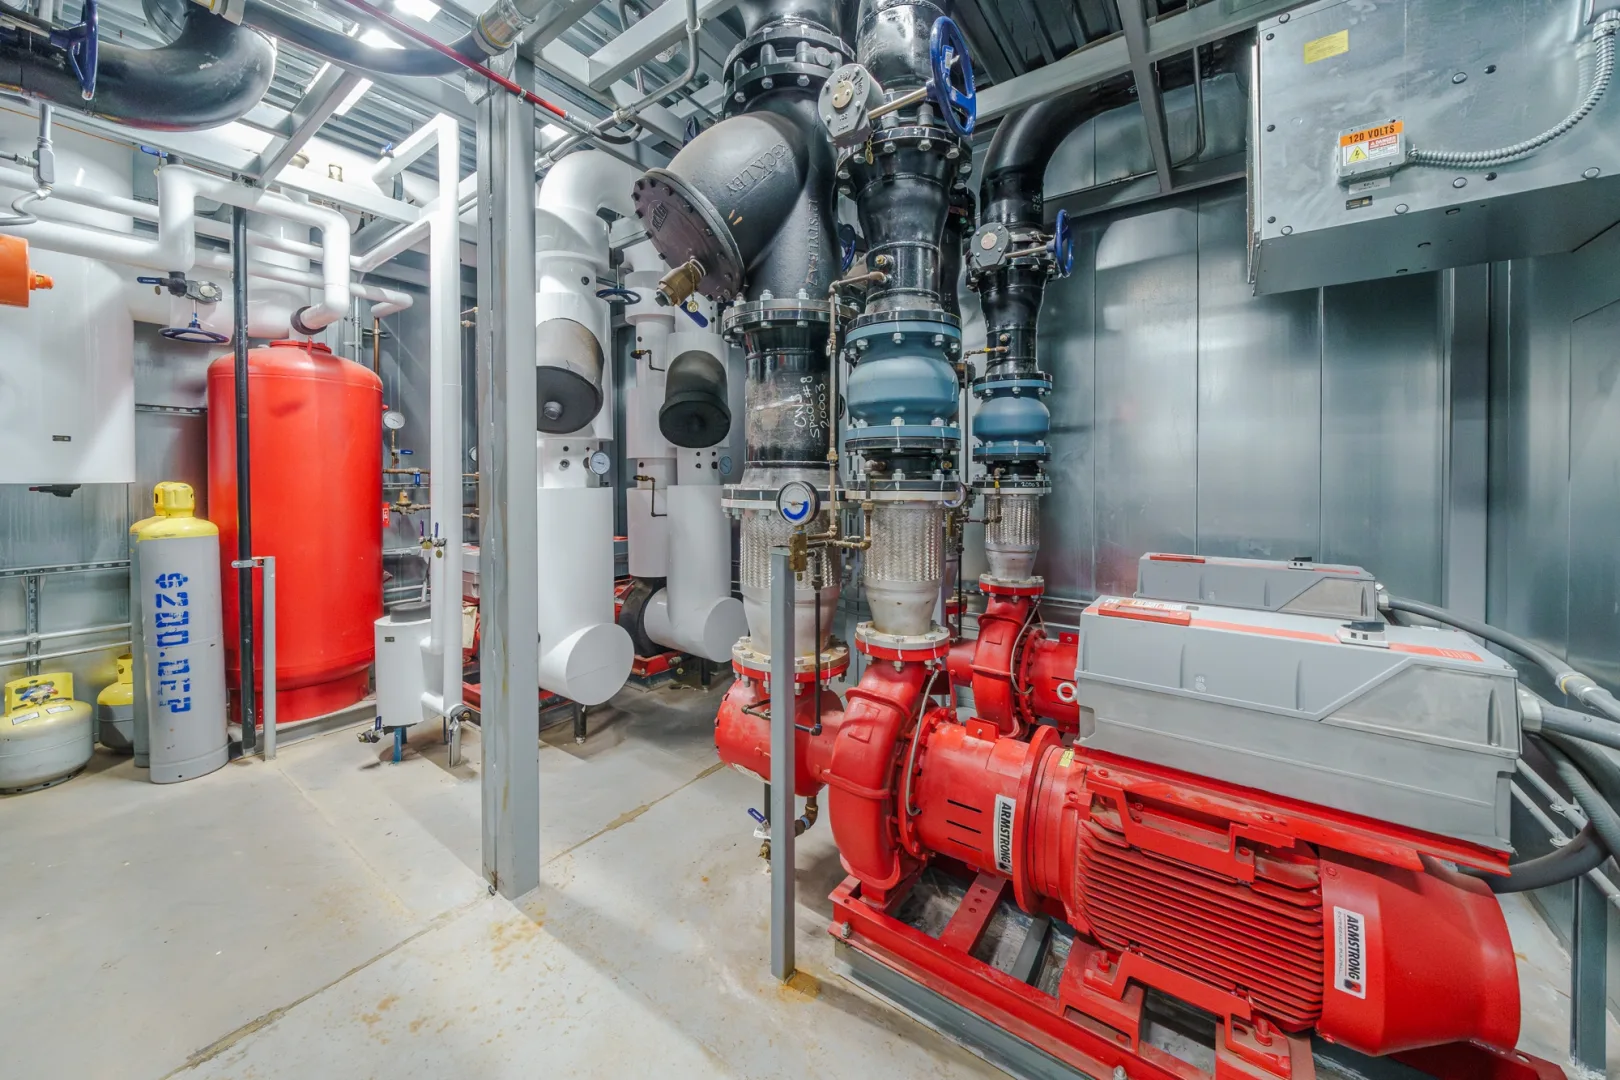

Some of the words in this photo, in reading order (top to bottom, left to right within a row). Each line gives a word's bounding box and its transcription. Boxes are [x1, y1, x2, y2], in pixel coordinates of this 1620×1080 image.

[1349, 132, 1364, 144] 120
[1368, 125, 1395, 139] VOLTS
[726, 141, 788, 196] KECKLEY
[815, 383, 830, 429] 20003
[1000, 802, 1012, 863] ARMSTRONG
[1346, 914, 1361, 980] ARMSTRONG
